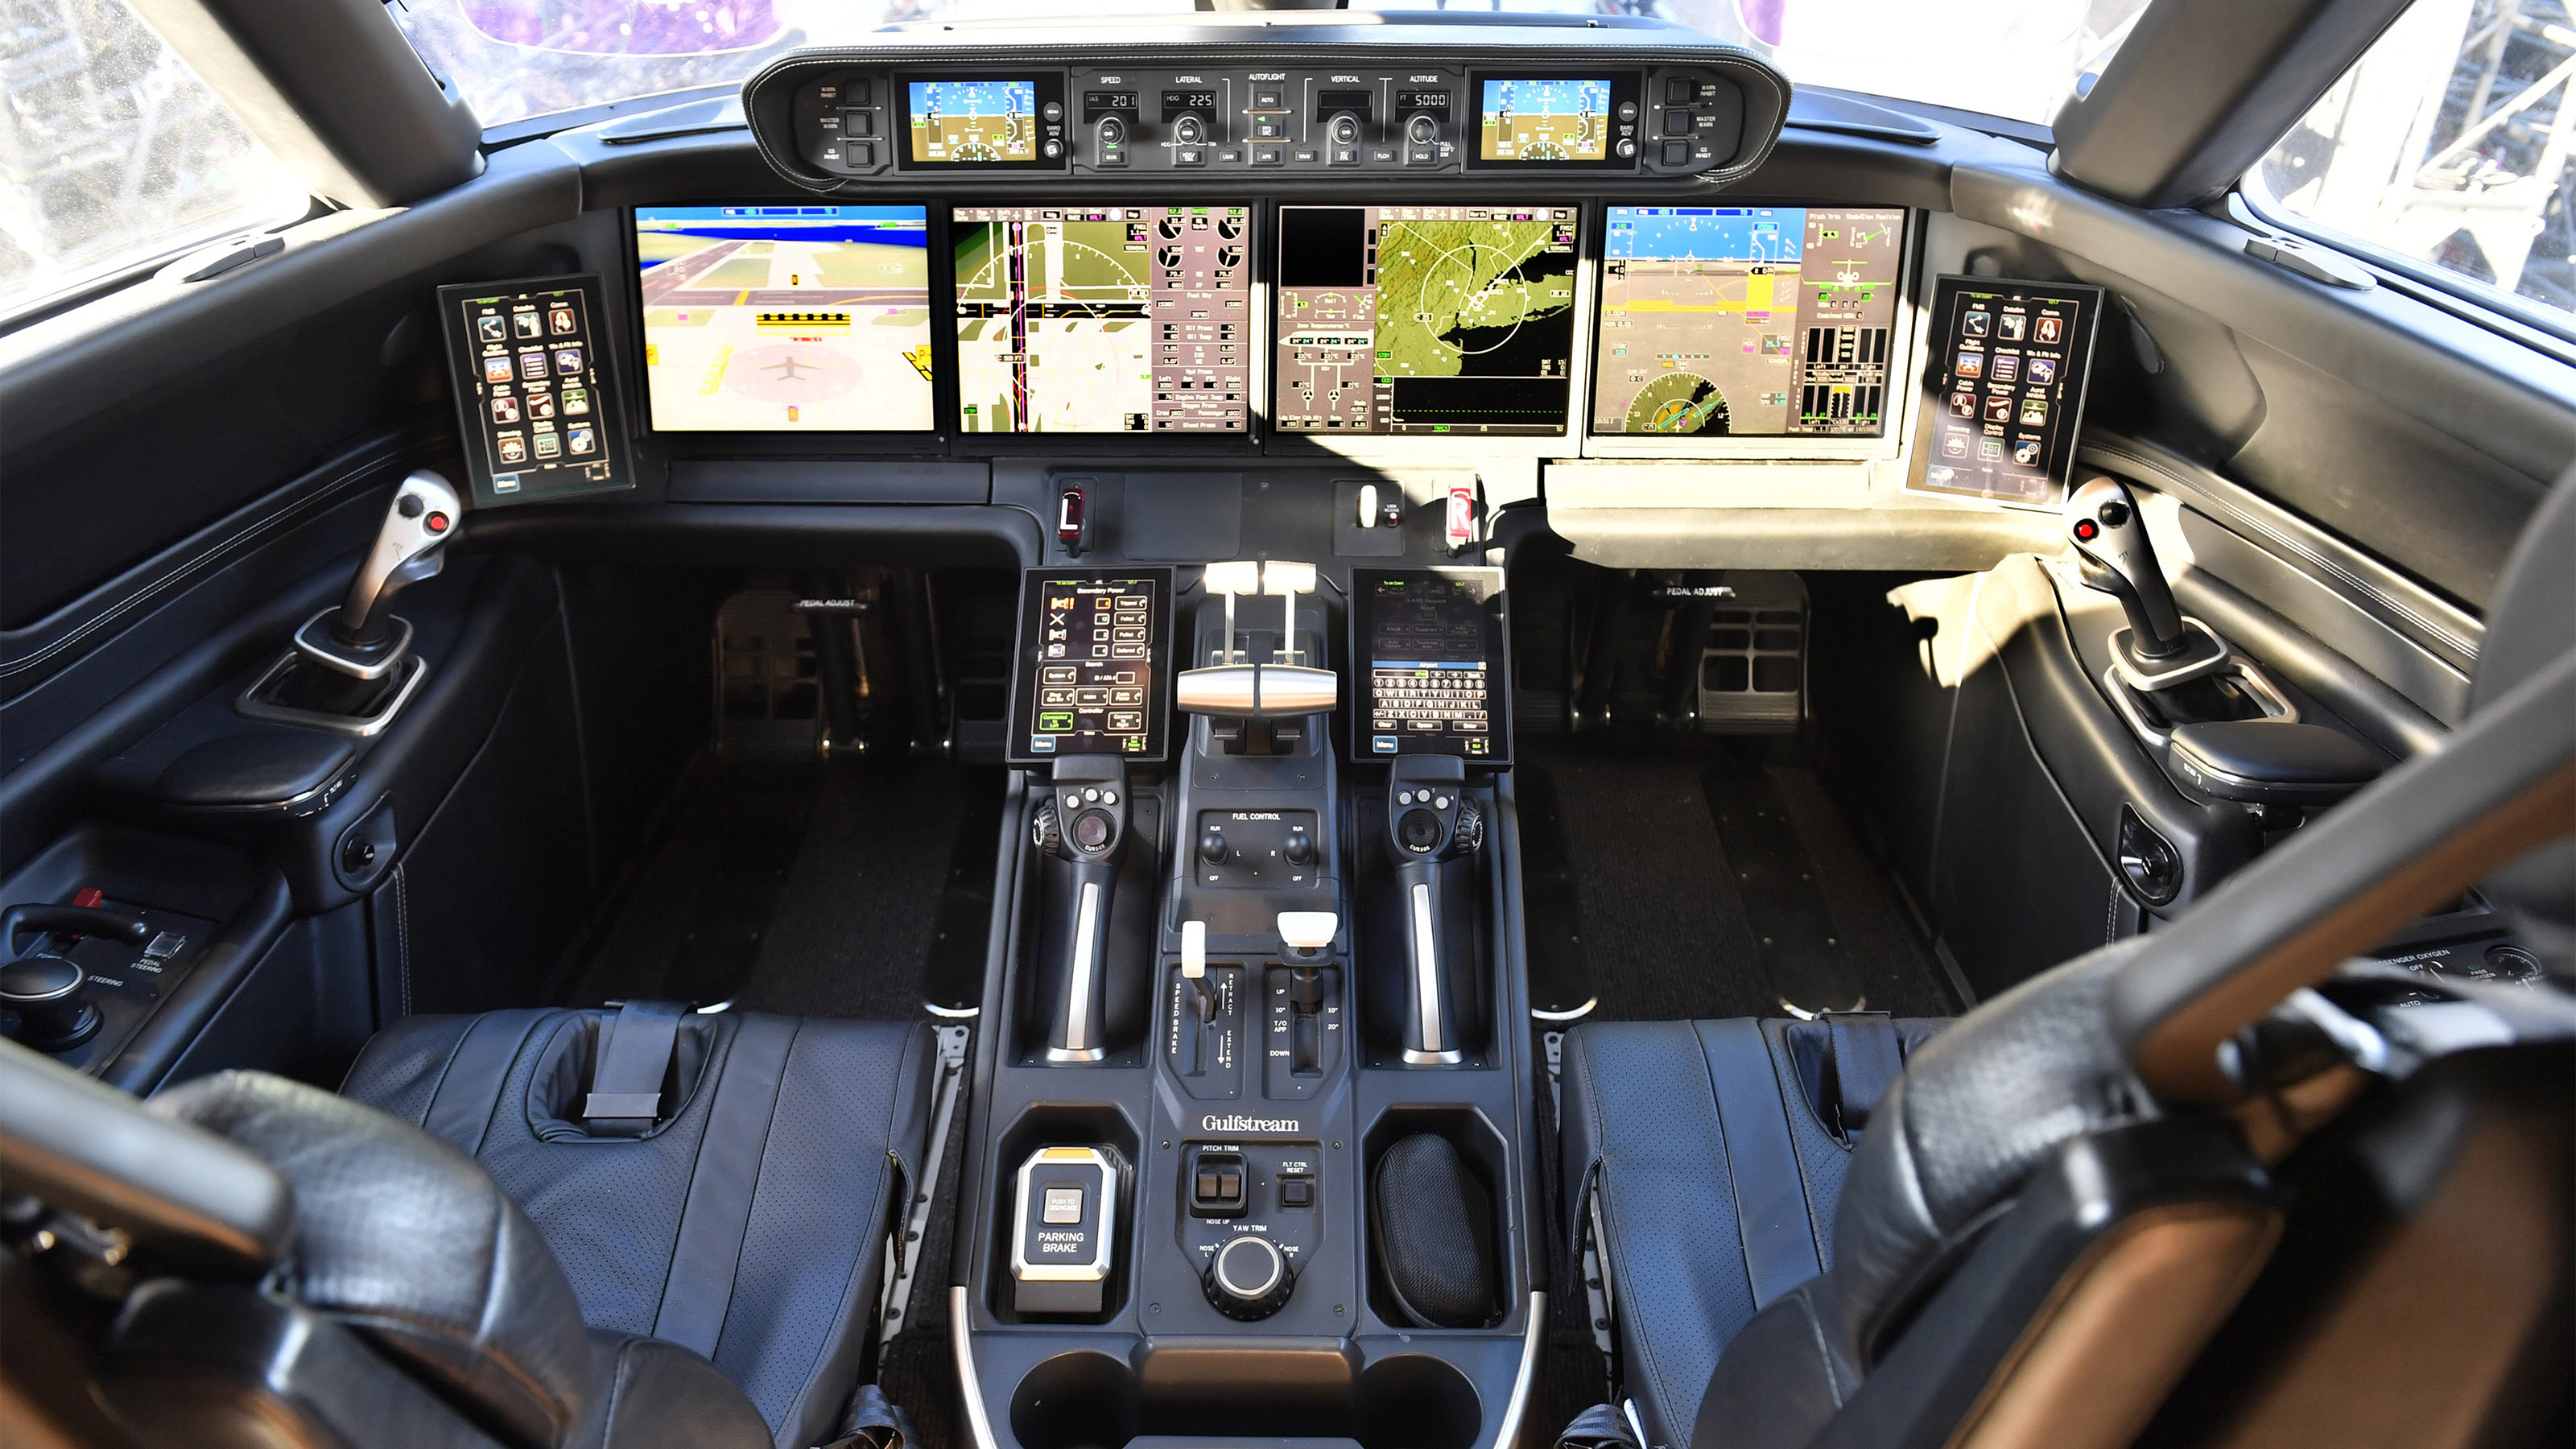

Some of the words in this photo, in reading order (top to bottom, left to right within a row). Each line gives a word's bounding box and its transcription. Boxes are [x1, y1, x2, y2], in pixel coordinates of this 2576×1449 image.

[1113, 95, 1135, 106] 201
[1190, 95, 1212, 106] 225
[1415, 94, 1445, 105] 5000
[2004, 306, 2025, 314] Datalink
[1995, 347, 2020, 355] Checklist
[1060, 498, 1078, 530] L
[1451, 496, 1470, 530] R
[1666, 587, 1691, 596] PEDAL
[1693, 587, 1724, 597] ADJUST
[799, 599, 824, 607] PEDAL
[825, 599, 856, 607] ADJUST
[1084, 844, 1106, 852] CURSOR
[1410, 844, 1430, 852] CURSOR
[2417, 949, 2450, 960] OXYGEN
[139, 958, 160, 967] PEDAL
[130, 963, 163, 973] STEERING
[2409, 964, 2424, 972] OFF
[88, 976, 123, 987] STEERING
[2400, 1001, 2421, 1009] AUTO
[1202, 1115, 1299, 1132] Gulfstream
[1038, 1232, 1084, 1241] PARKING
[1042, 1244, 1077, 1253] BRAKE
